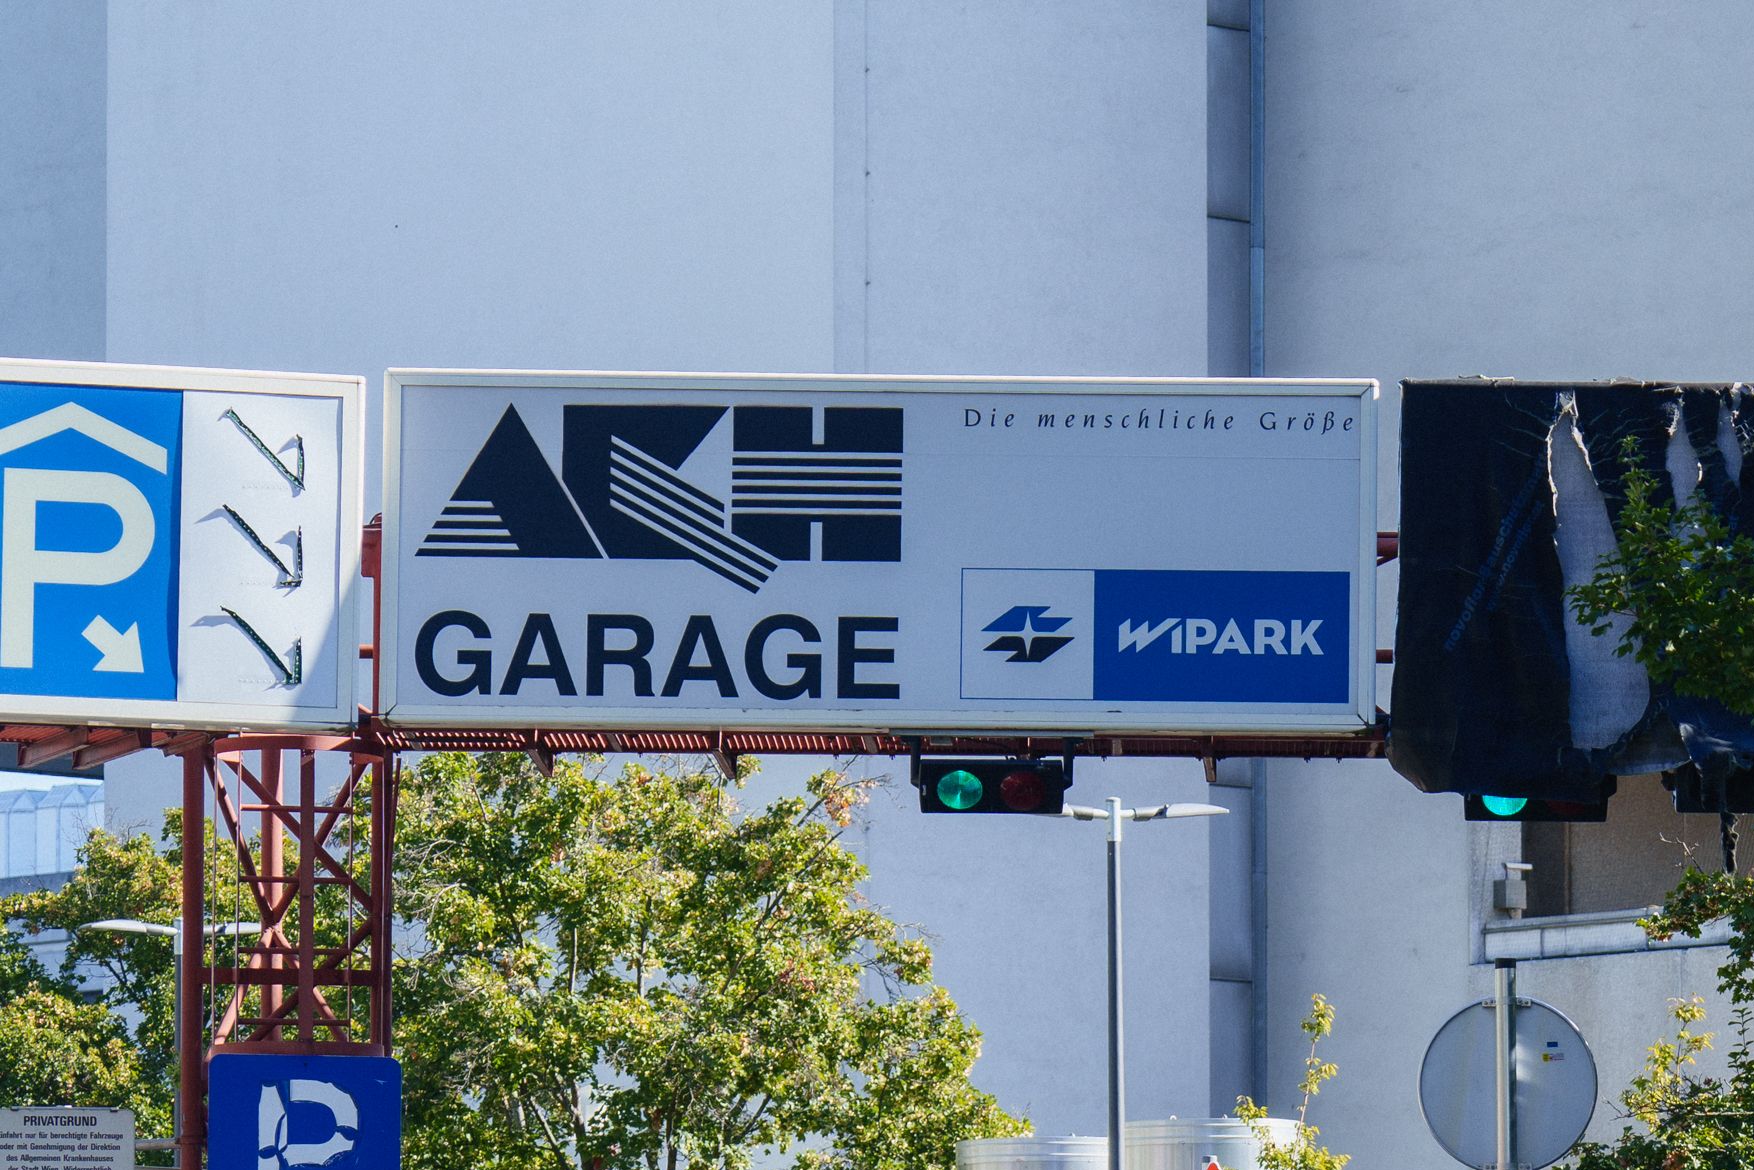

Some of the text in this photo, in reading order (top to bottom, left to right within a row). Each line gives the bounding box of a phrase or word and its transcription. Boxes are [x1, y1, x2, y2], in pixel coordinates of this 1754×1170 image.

[963, 408, 1354, 435] Die menschliche Größe
[414, 609, 901, 701] GARAGE
[23, 1115, 98, 1127] PRIVATGRUND
[38, 1130, 49, 1139] für
[49, 1131, 88, 1141] berechtigte
[89, 1131, 124, 1141] Fahrzeuge
[16, 1142, 28, 1151] mit
[29, 1142, 76, 1153] Genehmigung
[77, 1143, 89, 1151] der
[90, 1143, 121, 1151] Direktion
[5, 1153, 114, 1164] des Allgemeinen Krankenhauses
